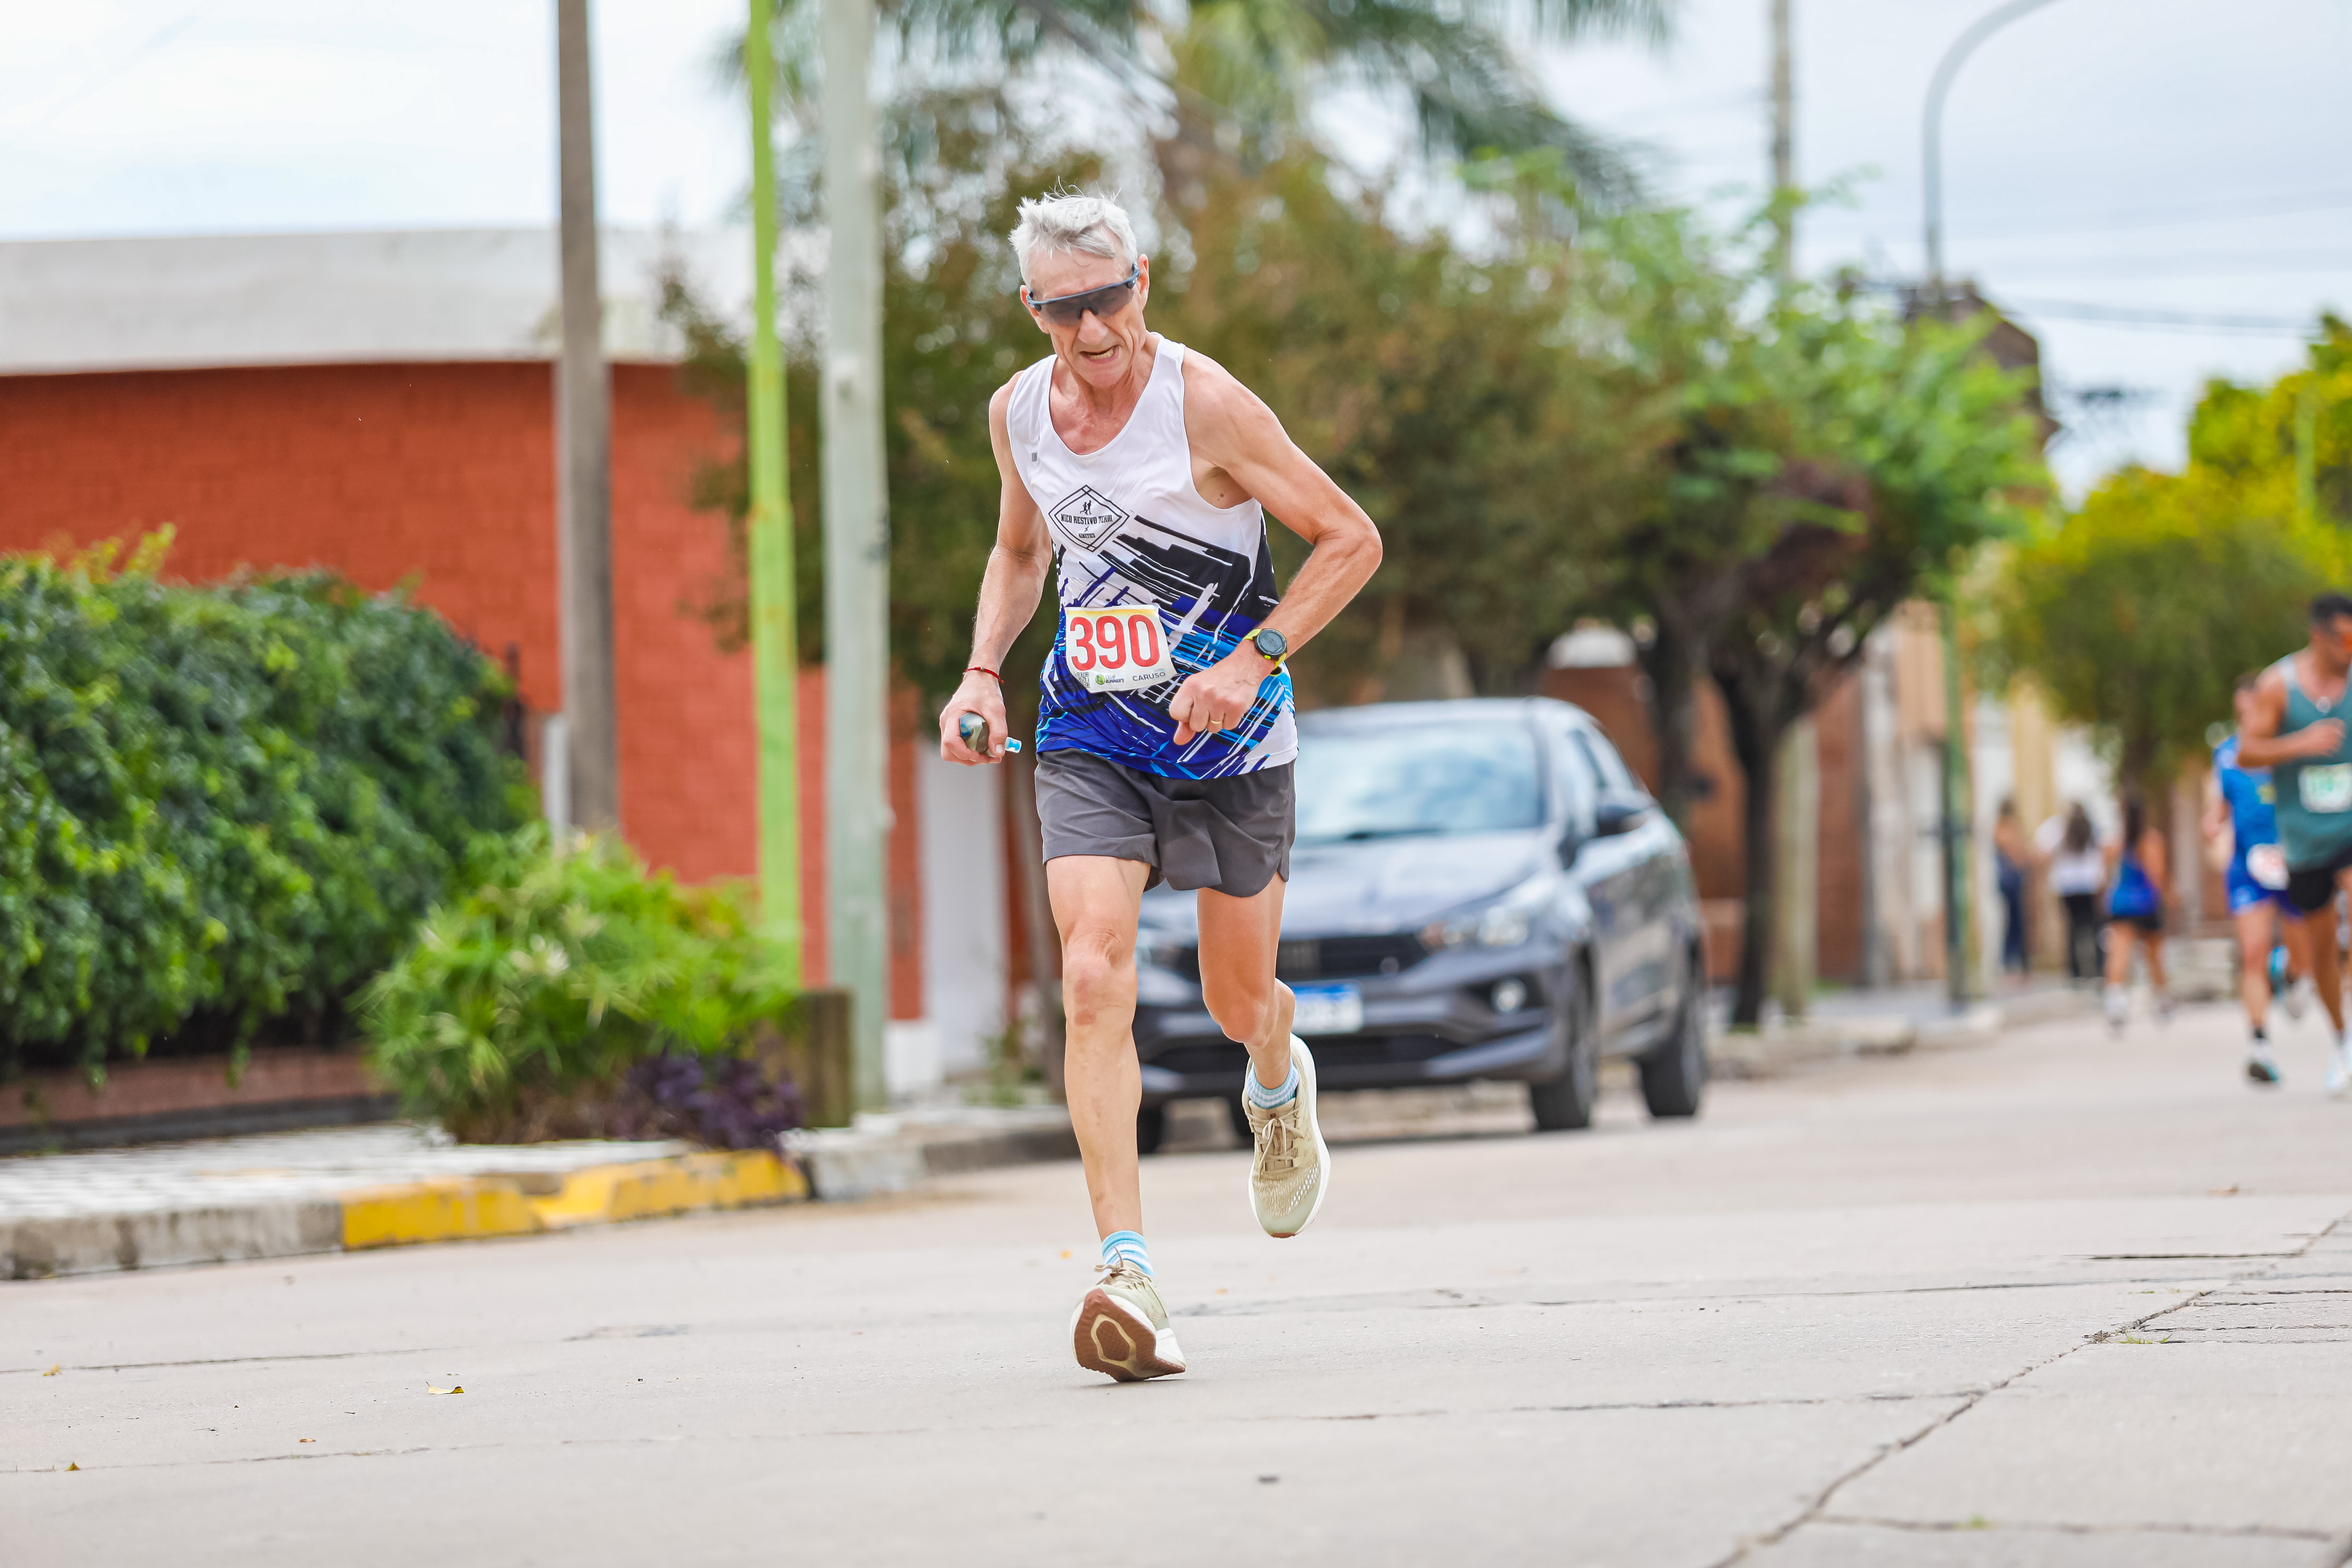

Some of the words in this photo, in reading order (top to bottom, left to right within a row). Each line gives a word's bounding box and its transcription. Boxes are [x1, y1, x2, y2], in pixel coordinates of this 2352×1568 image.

[1061, 513, 1072, 523] NICO
[1073, 516, 1097, 524] RESTIVO
[1098, 515, 1113, 523] TEAM
[1070, 614, 1160, 671] 390
[1132, 672, 1166, 681] CARUSO
